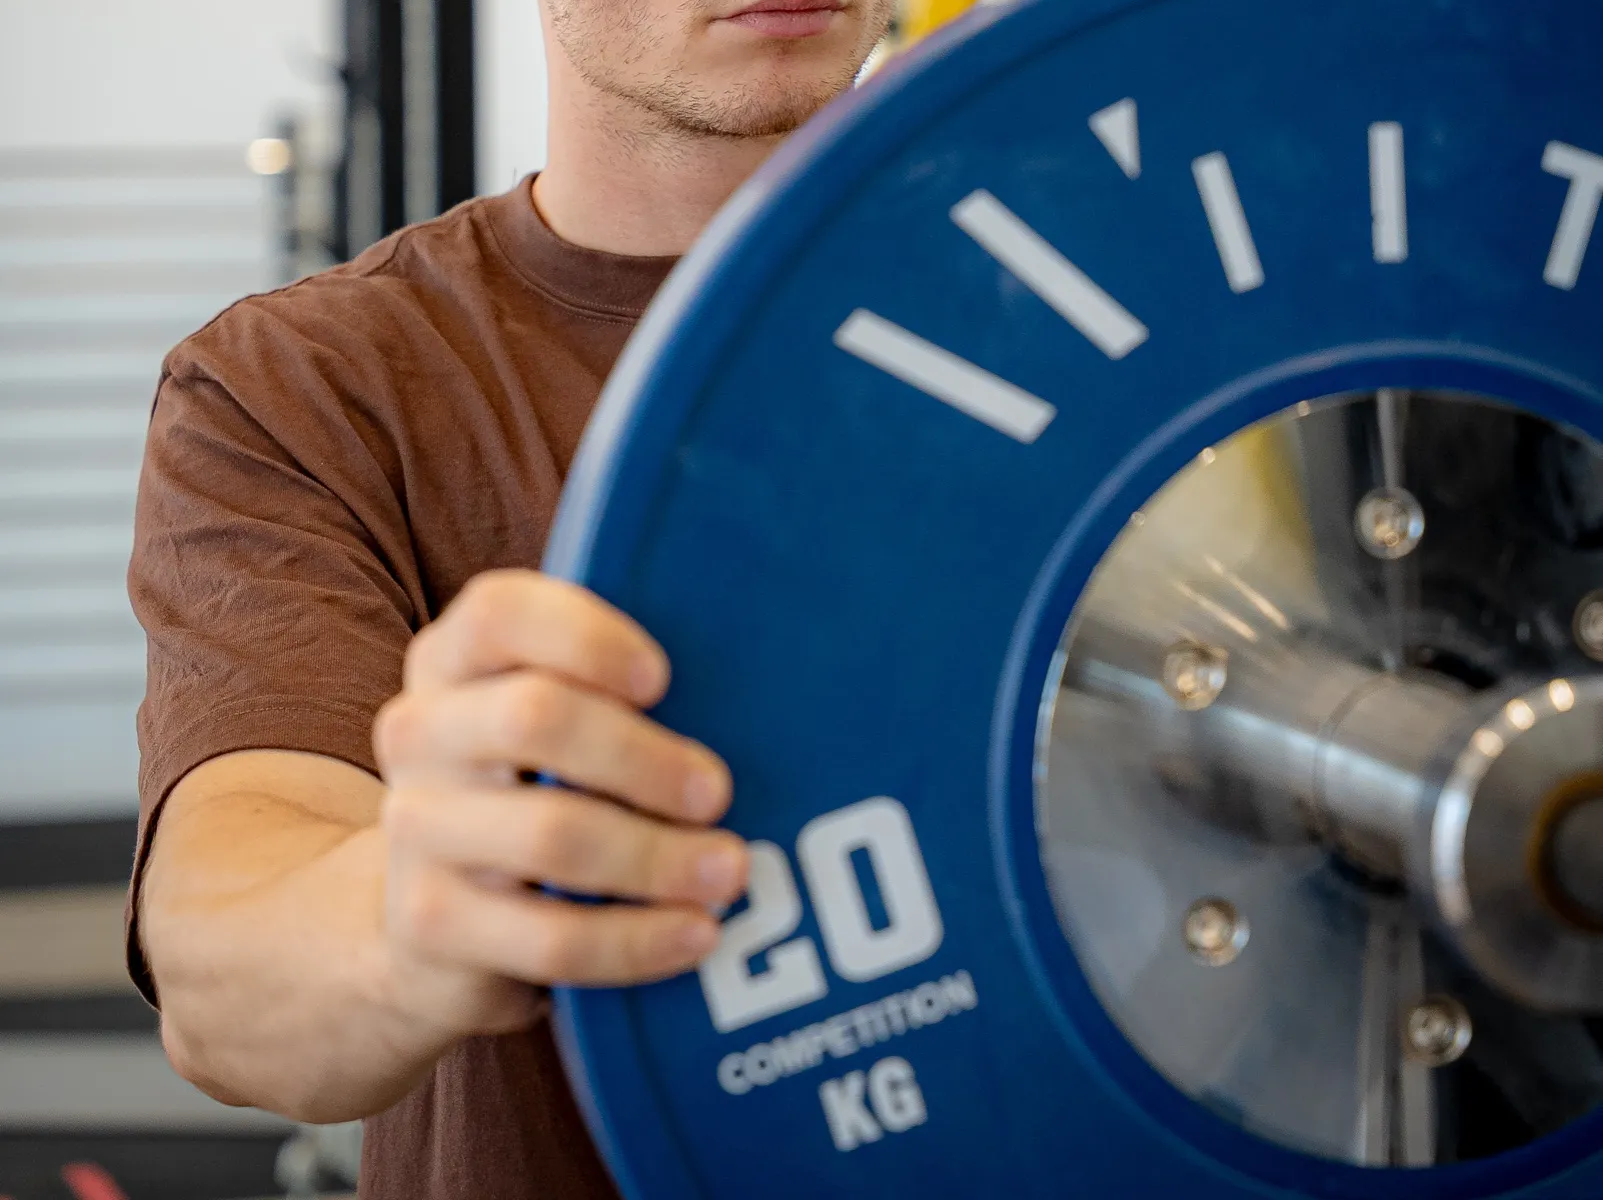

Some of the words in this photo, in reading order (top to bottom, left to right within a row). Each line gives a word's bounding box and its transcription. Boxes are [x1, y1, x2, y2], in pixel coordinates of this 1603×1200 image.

[699, 795, 944, 1034] 20
[717, 968, 978, 1095] COMPETITION
[818, 1055, 928, 1152] KG
